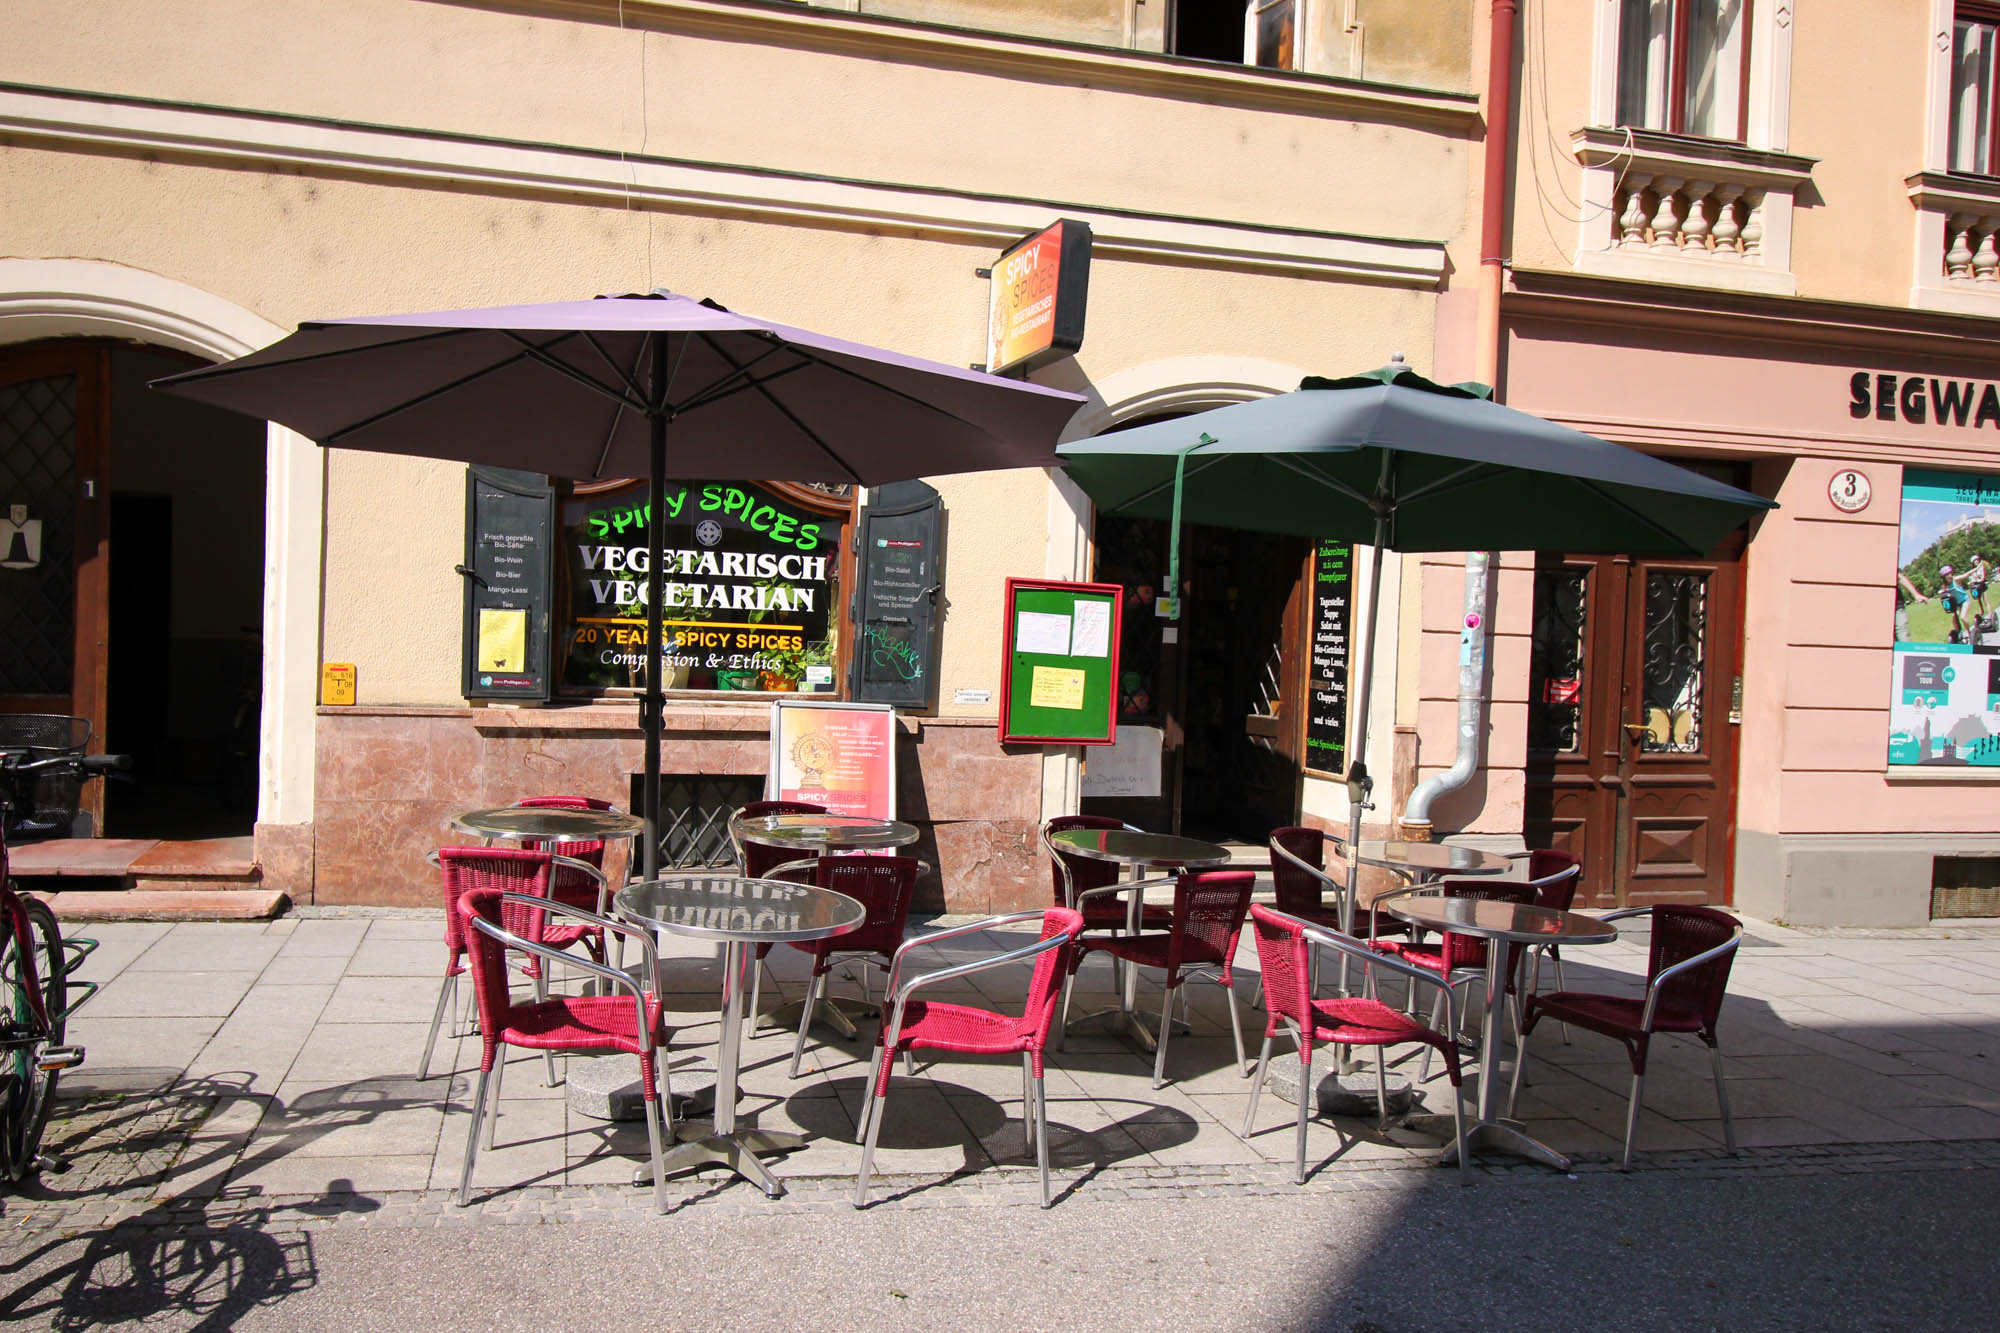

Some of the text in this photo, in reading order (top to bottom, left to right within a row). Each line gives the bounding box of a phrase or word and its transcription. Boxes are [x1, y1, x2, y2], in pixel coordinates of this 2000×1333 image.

[1006, 244, 1040, 285] SPICY
[1013, 263, 1055, 308] SPICES
[1849, 371, 2000, 430] SEGWA
[1844, 473, 1856, 497] 3
[700, 484, 821, 550] SPICES
[484, 533, 504, 541] Frisch
[494, 556, 523, 564] Bio-Wein
[578, 544, 827, 581] VEGETARISCH
[487, 586, 529, 594] Mango-Lassi
[1324, 609, 1339, 620] Suppe
[576, 628, 597, 644] 20
[674, 631, 731, 649] SPICY
[736, 633, 804, 651] SPICES
[601, 649, 781, 673] Compssion & Ethics
[797, 792, 829, 801] SPICY
